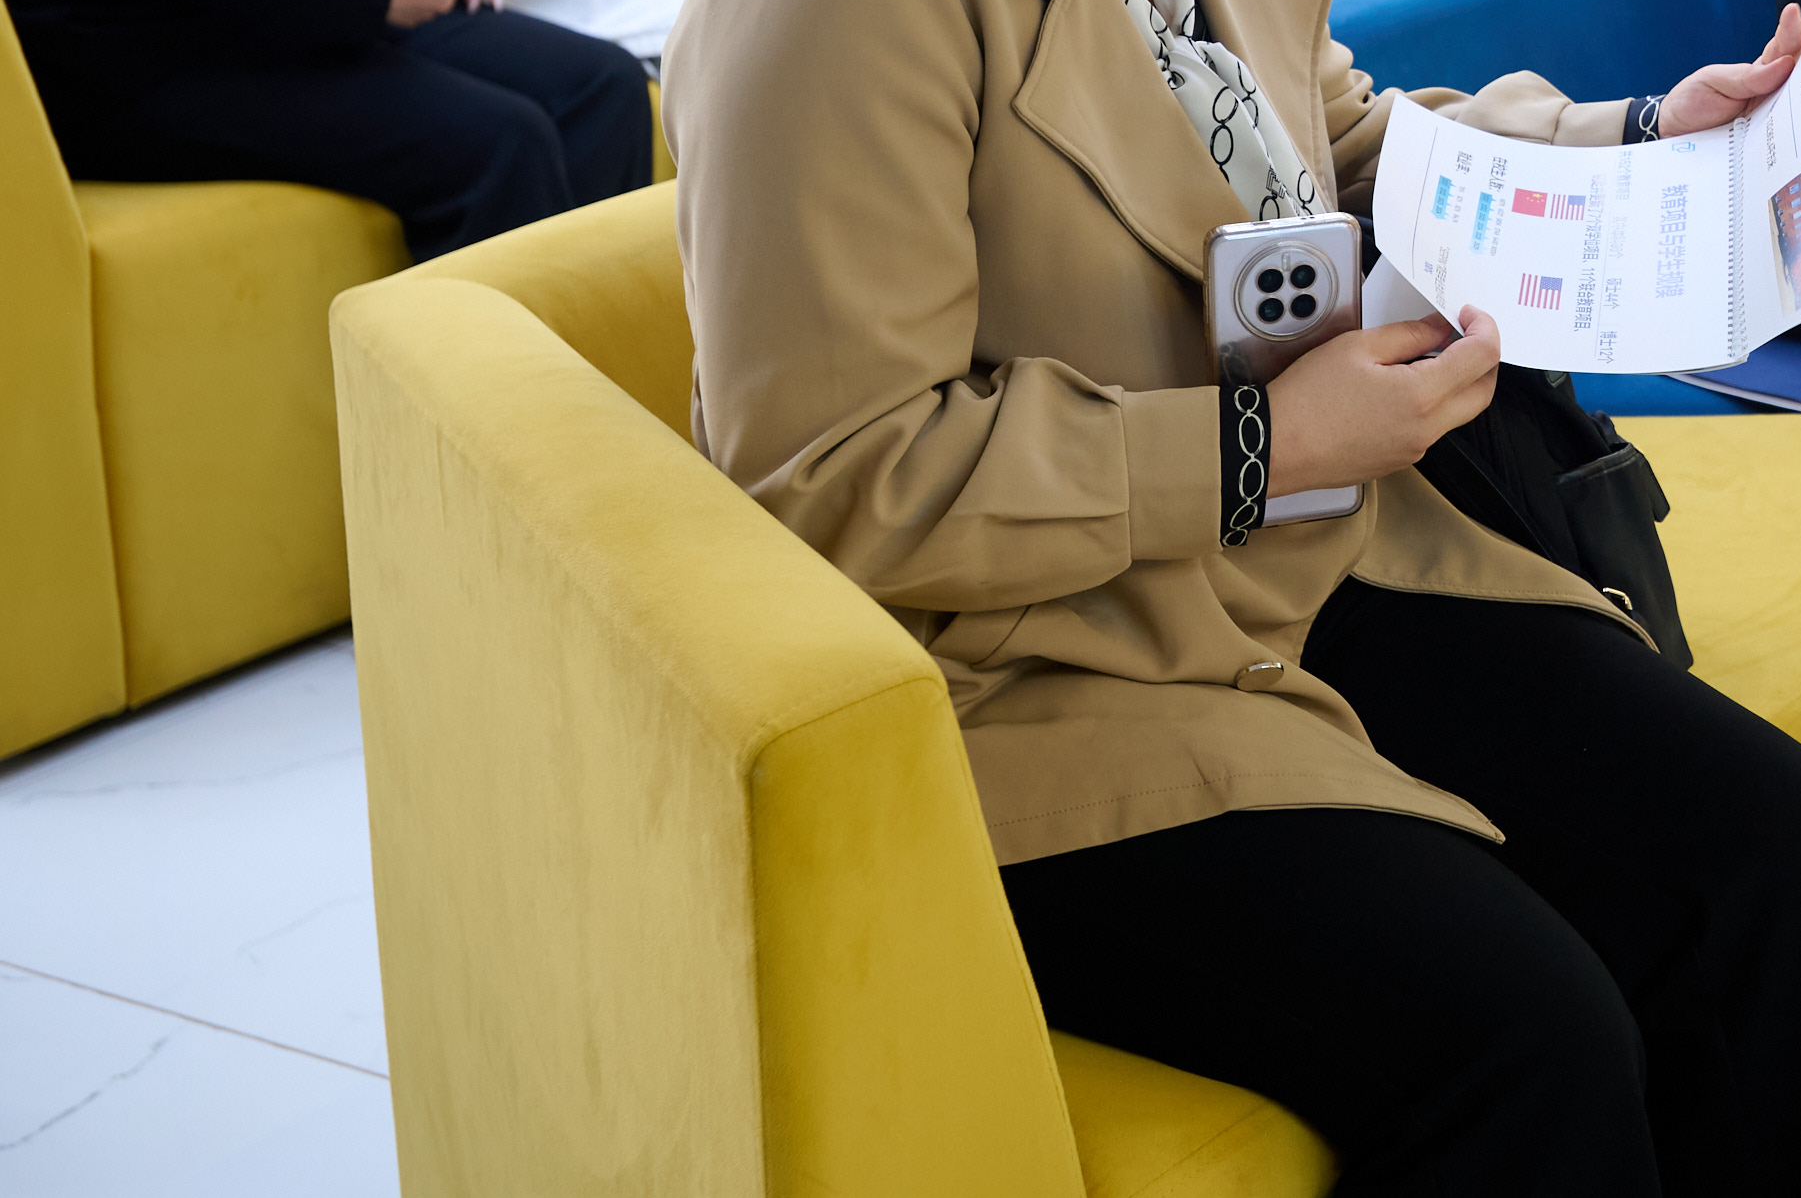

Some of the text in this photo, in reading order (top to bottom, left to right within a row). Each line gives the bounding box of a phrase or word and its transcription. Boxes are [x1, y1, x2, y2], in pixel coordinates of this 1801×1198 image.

[1655, 184, 1687, 299] 教育项目与学生规模
[1604, 278, 1622, 310] 硕士44个
[1599, 331, 1618, 364] 博士12个
